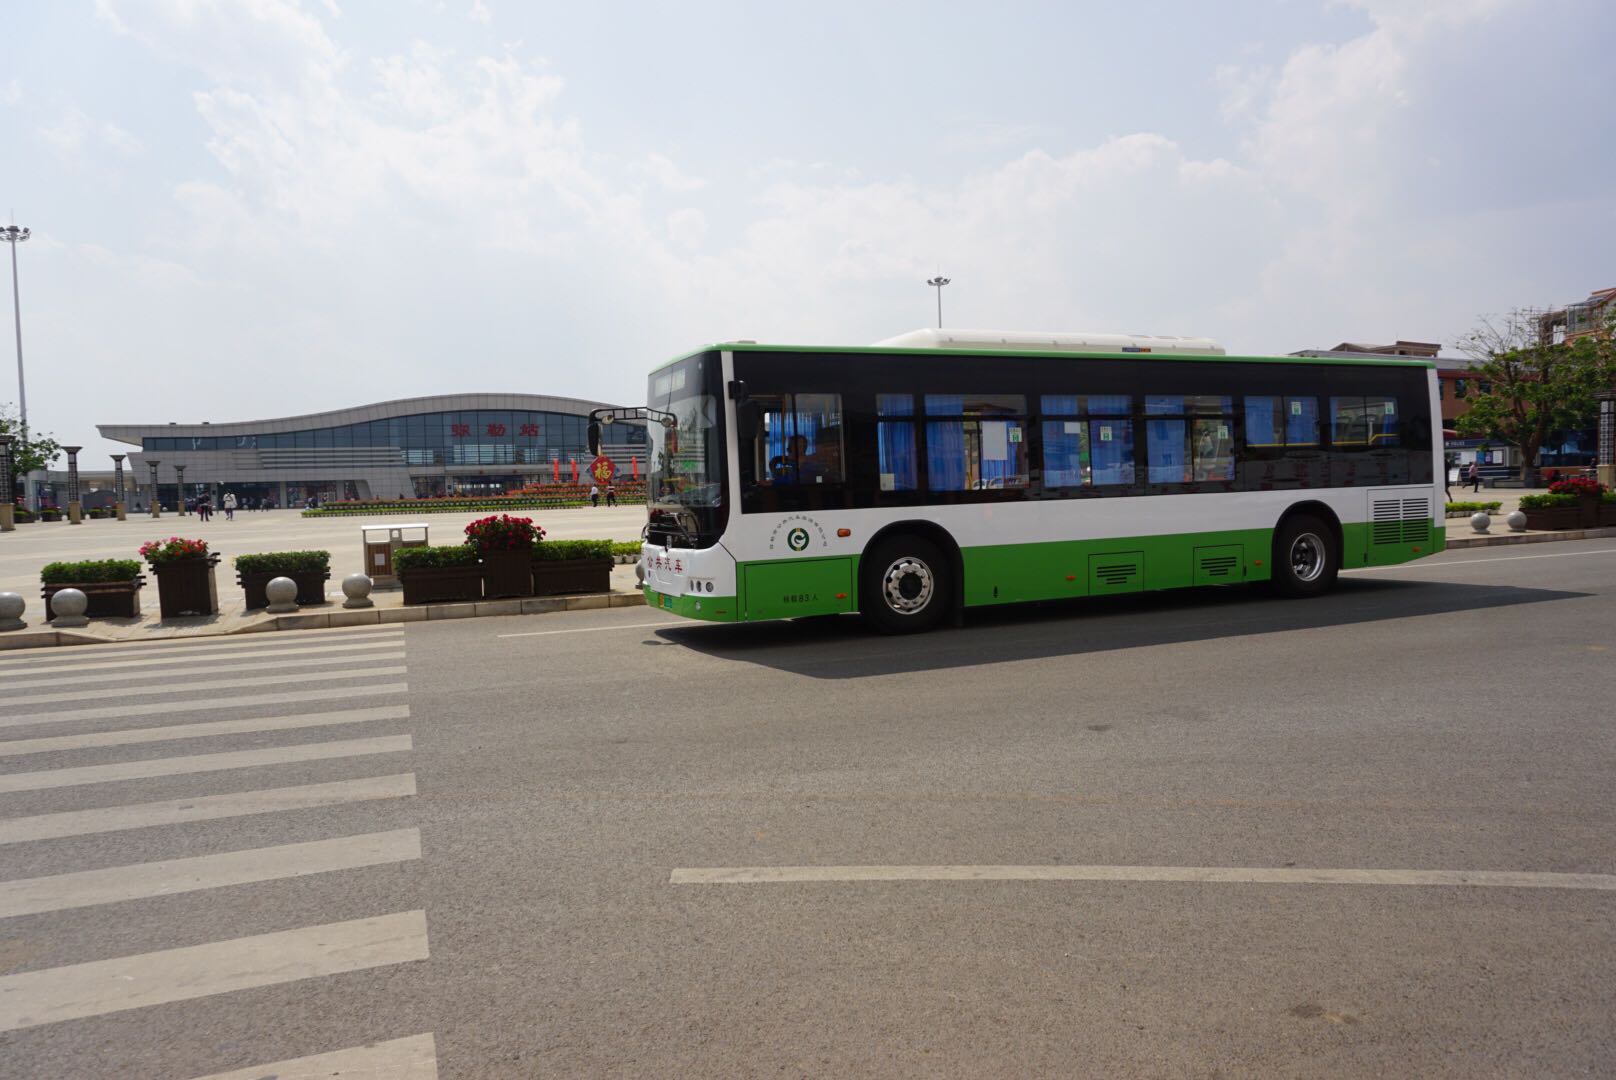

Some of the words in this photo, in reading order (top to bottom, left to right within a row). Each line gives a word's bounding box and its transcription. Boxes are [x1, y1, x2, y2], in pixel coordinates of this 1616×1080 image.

[594, 461, 612, 479] 福
[647, 555, 683, 574] 公共汽车
